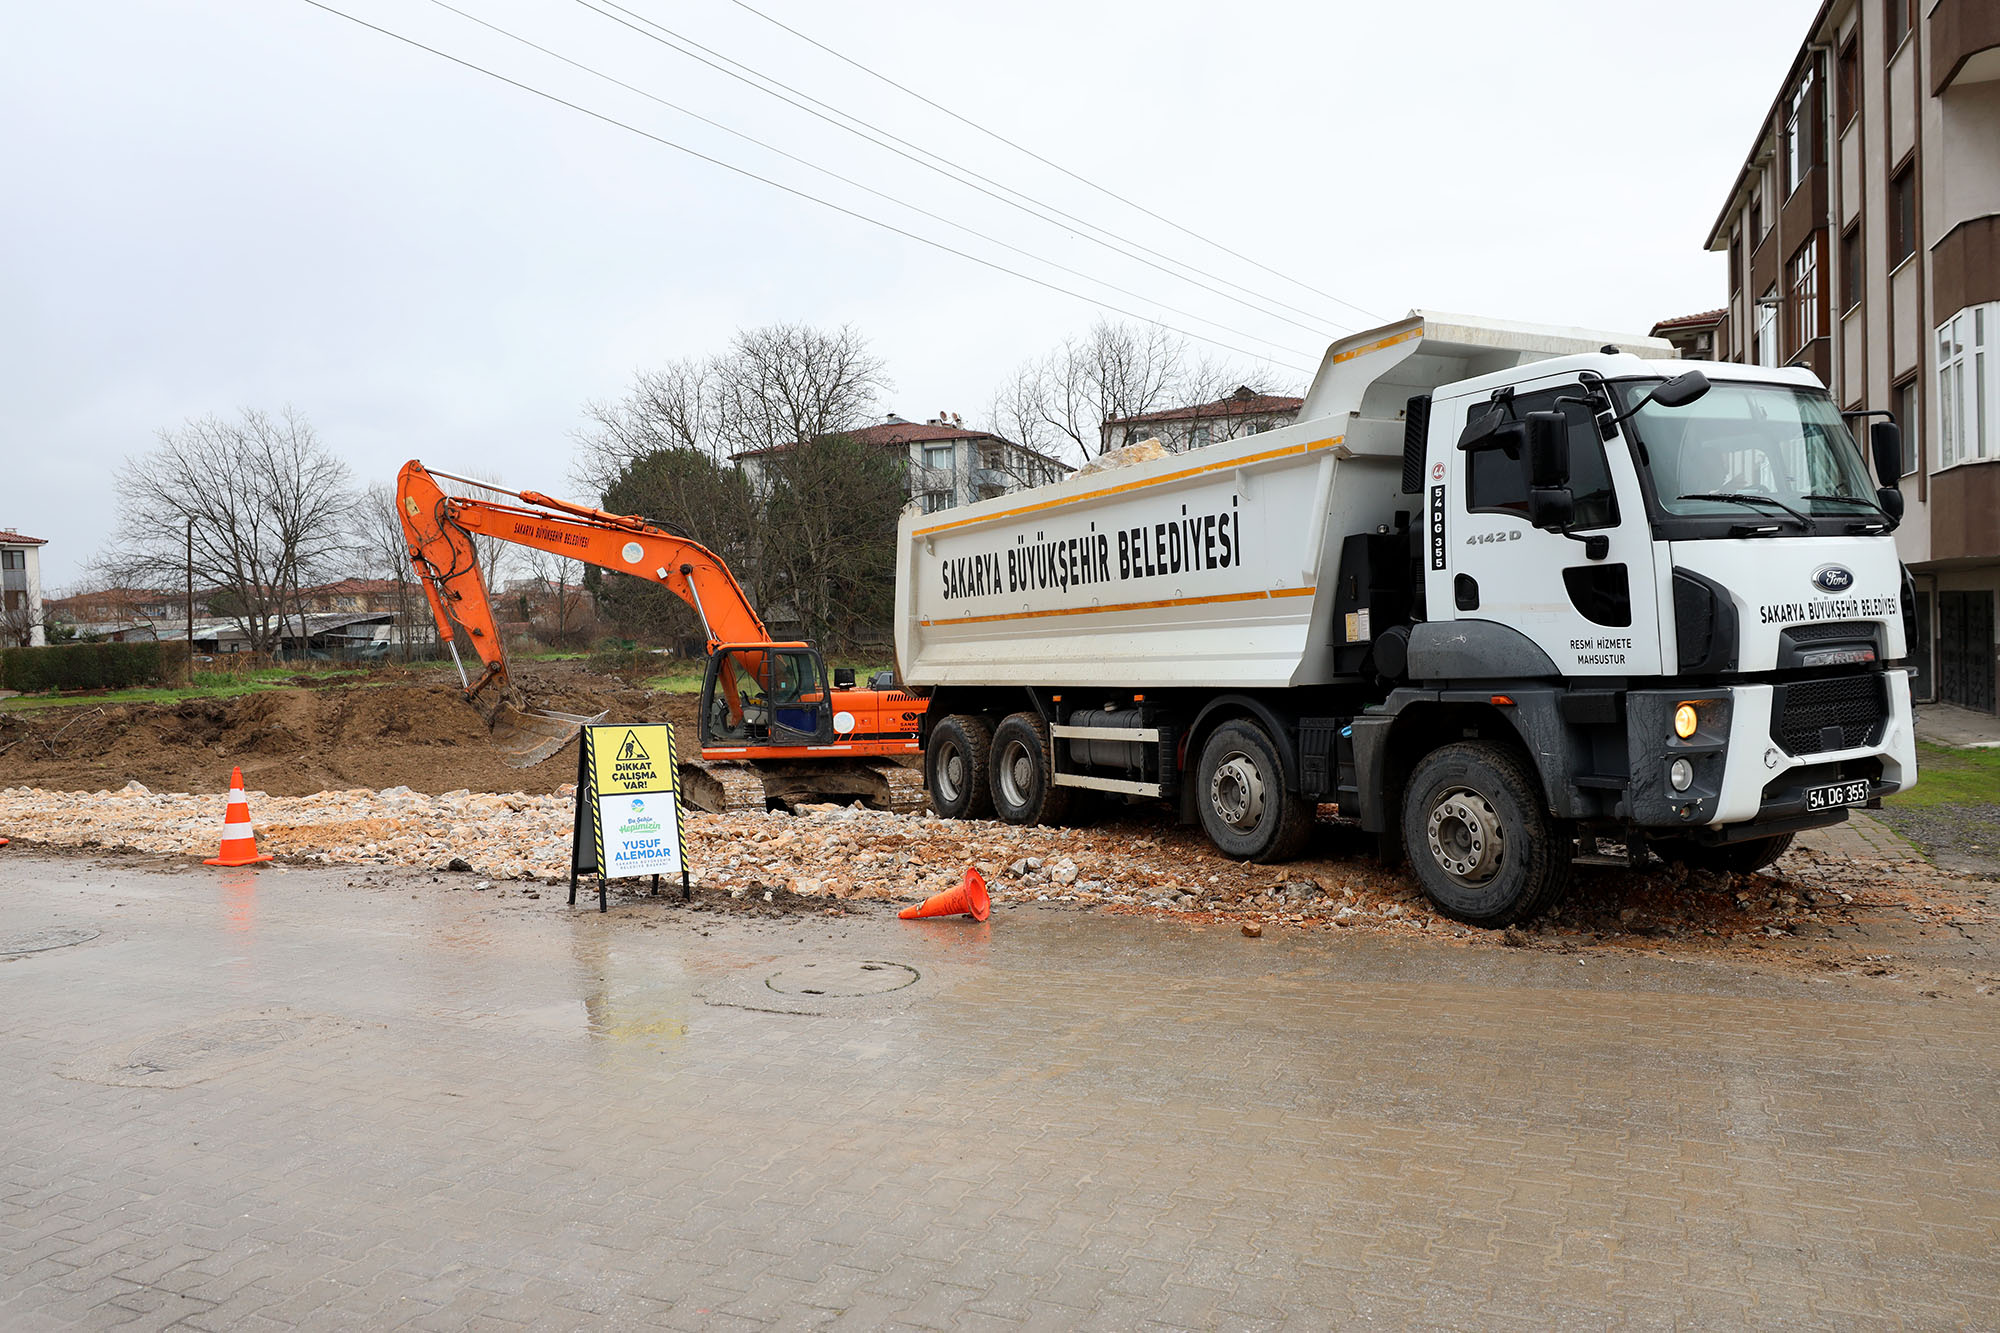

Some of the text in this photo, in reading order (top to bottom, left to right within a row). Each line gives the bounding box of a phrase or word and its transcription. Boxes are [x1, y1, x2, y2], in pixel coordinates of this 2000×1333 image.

[514, 522, 534, 536] SAKARYA
[1466, 530, 1522, 545] 4142 D
[942, 494, 1241, 600] SAKARYA BÜYÜKŞEHİR BELEDİYESİ
[1826, 570, 1848, 586] Ford
[1760, 593, 1897, 624] SAKARYA BÜYÜKŞEHİR BELEDİYESİ
[1570, 637, 1631, 649] RESMİ HİZMETE
[1577, 654, 1626, 664] MAHSUSTUR
[615, 762, 652, 771] DİKKAT
[612, 771, 657, 782] ÇALIŞMA
[623, 781, 648, 789] VAR!
[1810, 783, 1865, 807] 54 DG 355
[619, 821, 661, 833] Hepimizin
[622, 838, 661, 850] YUSUF
[615, 848, 671, 861] ALEMDAR
